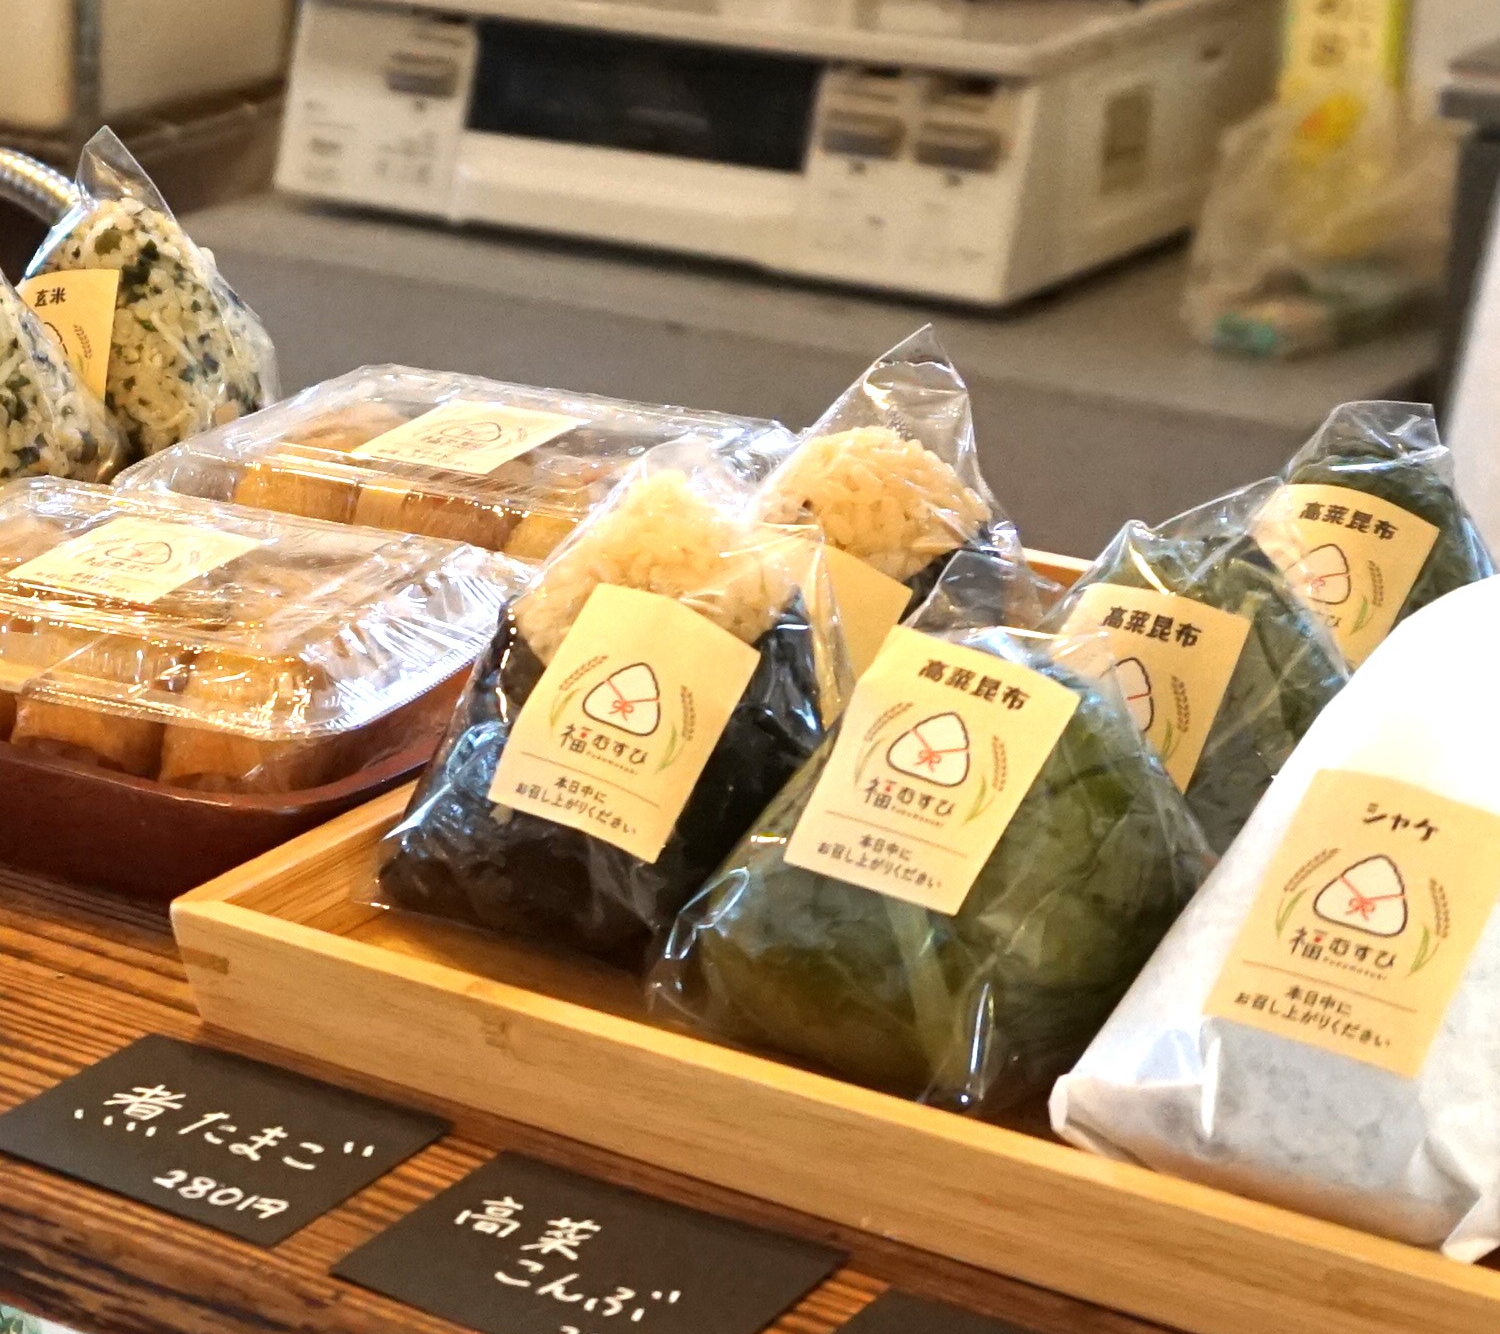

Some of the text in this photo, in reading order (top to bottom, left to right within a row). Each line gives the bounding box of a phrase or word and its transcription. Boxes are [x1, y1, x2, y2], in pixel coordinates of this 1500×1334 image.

[34, 287, 67, 308] 玄米
[1299, 501, 1399, 540] 高菜昆布
[1100, 605, 1203, 648] 高菜昆布
[917, 658, 1032, 711] 高菜昆布
[1362, 802, 1439, 842] シャケ
[72, 1083, 377, 1173] 煮たまご
[151, 1167, 290, 1222] 280円
[454, 1193, 603, 1262] 高菜
[494, 1260, 684, 1324] こんぶ
